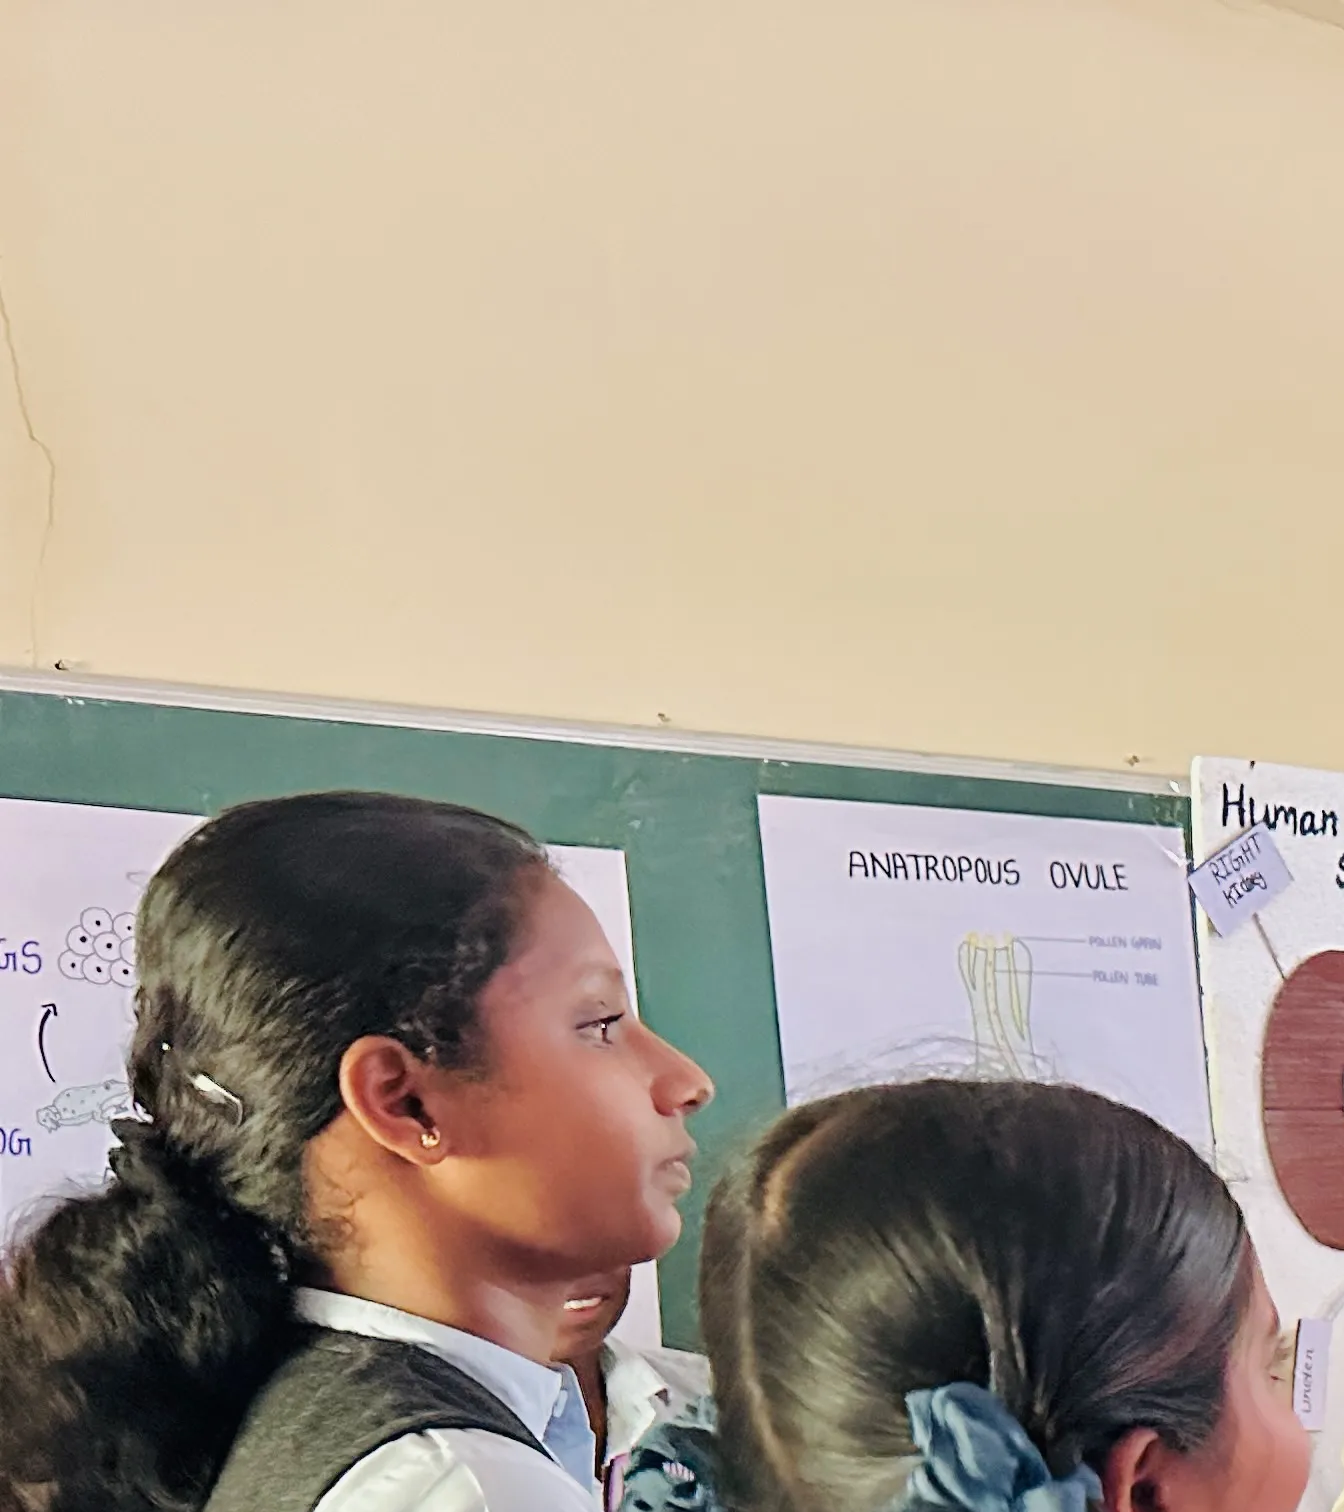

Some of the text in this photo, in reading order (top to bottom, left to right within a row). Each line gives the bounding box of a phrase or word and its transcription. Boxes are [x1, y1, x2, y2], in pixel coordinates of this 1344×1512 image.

[1221, 782, 1338, 836] Human
[848, 850, 1129, 891] ANATROPOUS OVULE
